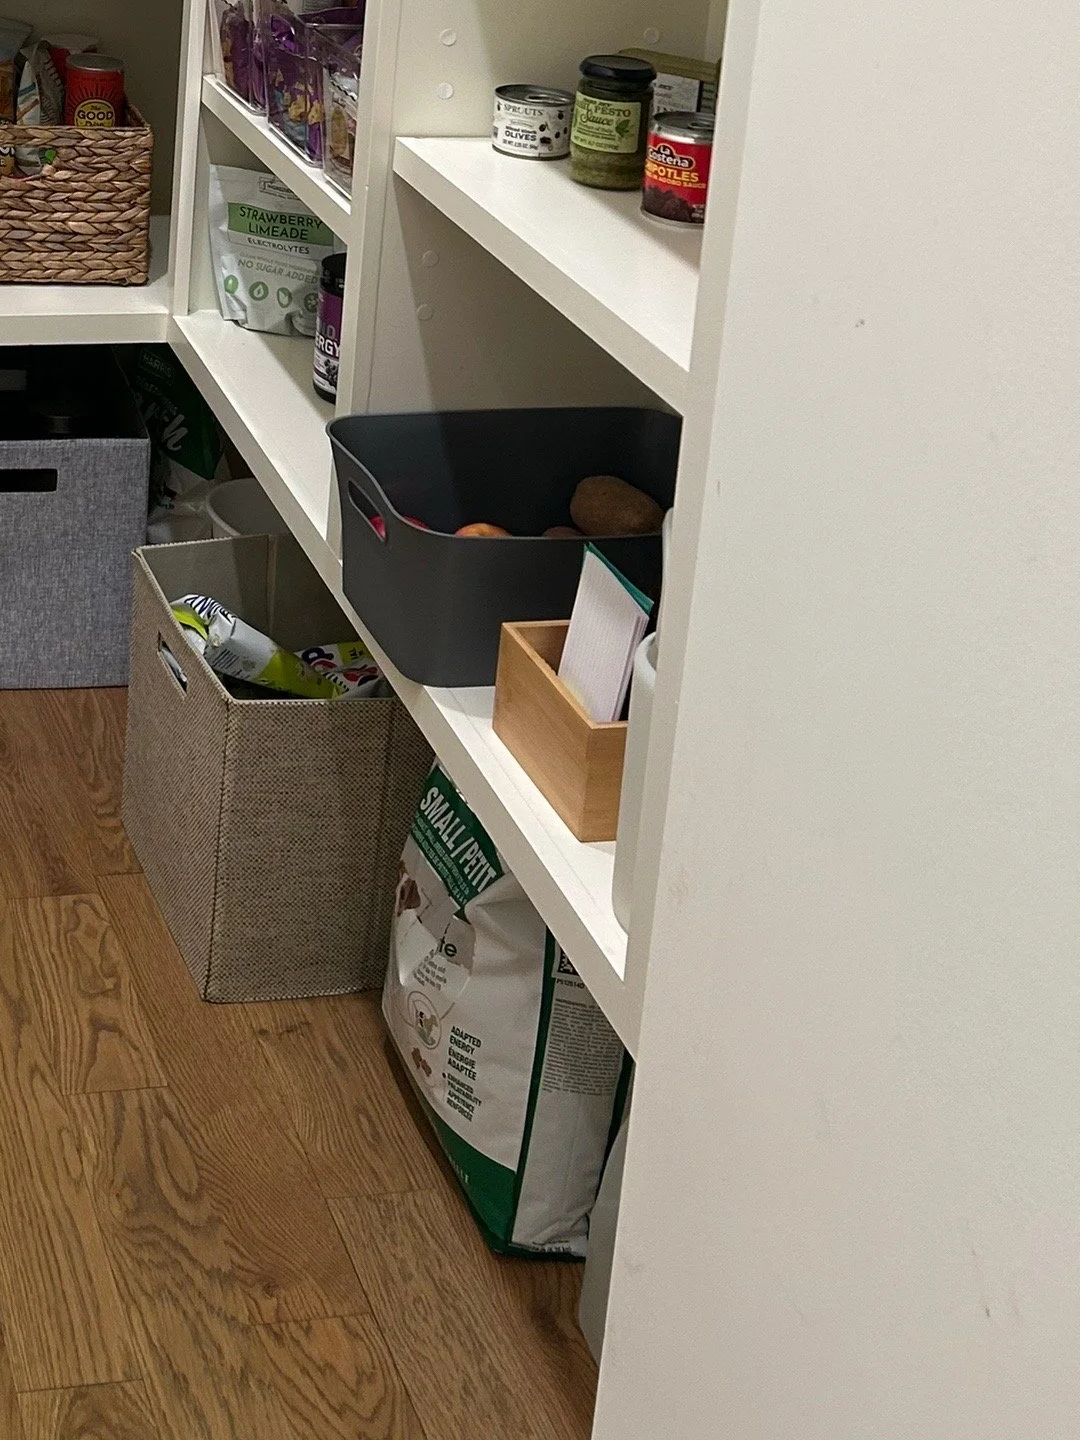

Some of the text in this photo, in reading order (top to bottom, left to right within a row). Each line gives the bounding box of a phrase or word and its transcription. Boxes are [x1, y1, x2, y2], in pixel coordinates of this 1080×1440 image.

[78, 110, 113, 120] GOOD
[581, 104, 612, 126] Sauce
[595, 105, 631, 117] PESTO
[505, 131, 536, 141] OLIVES
[660, 146, 670, 155] La
[240, 206, 322, 229] STRAWBERRY
[249, 223, 309, 240] LIMEADE
[248, 238, 310, 255] ELECTROLYTES
[239, 259, 254, 269] NO
[256, 262, 284, 276] SUGAR
[286, 271, 319, 284] ADDED
[449, 1035, 475, 1055] ENERGY
[451, 1026, 481, 1048] ADAPTED
